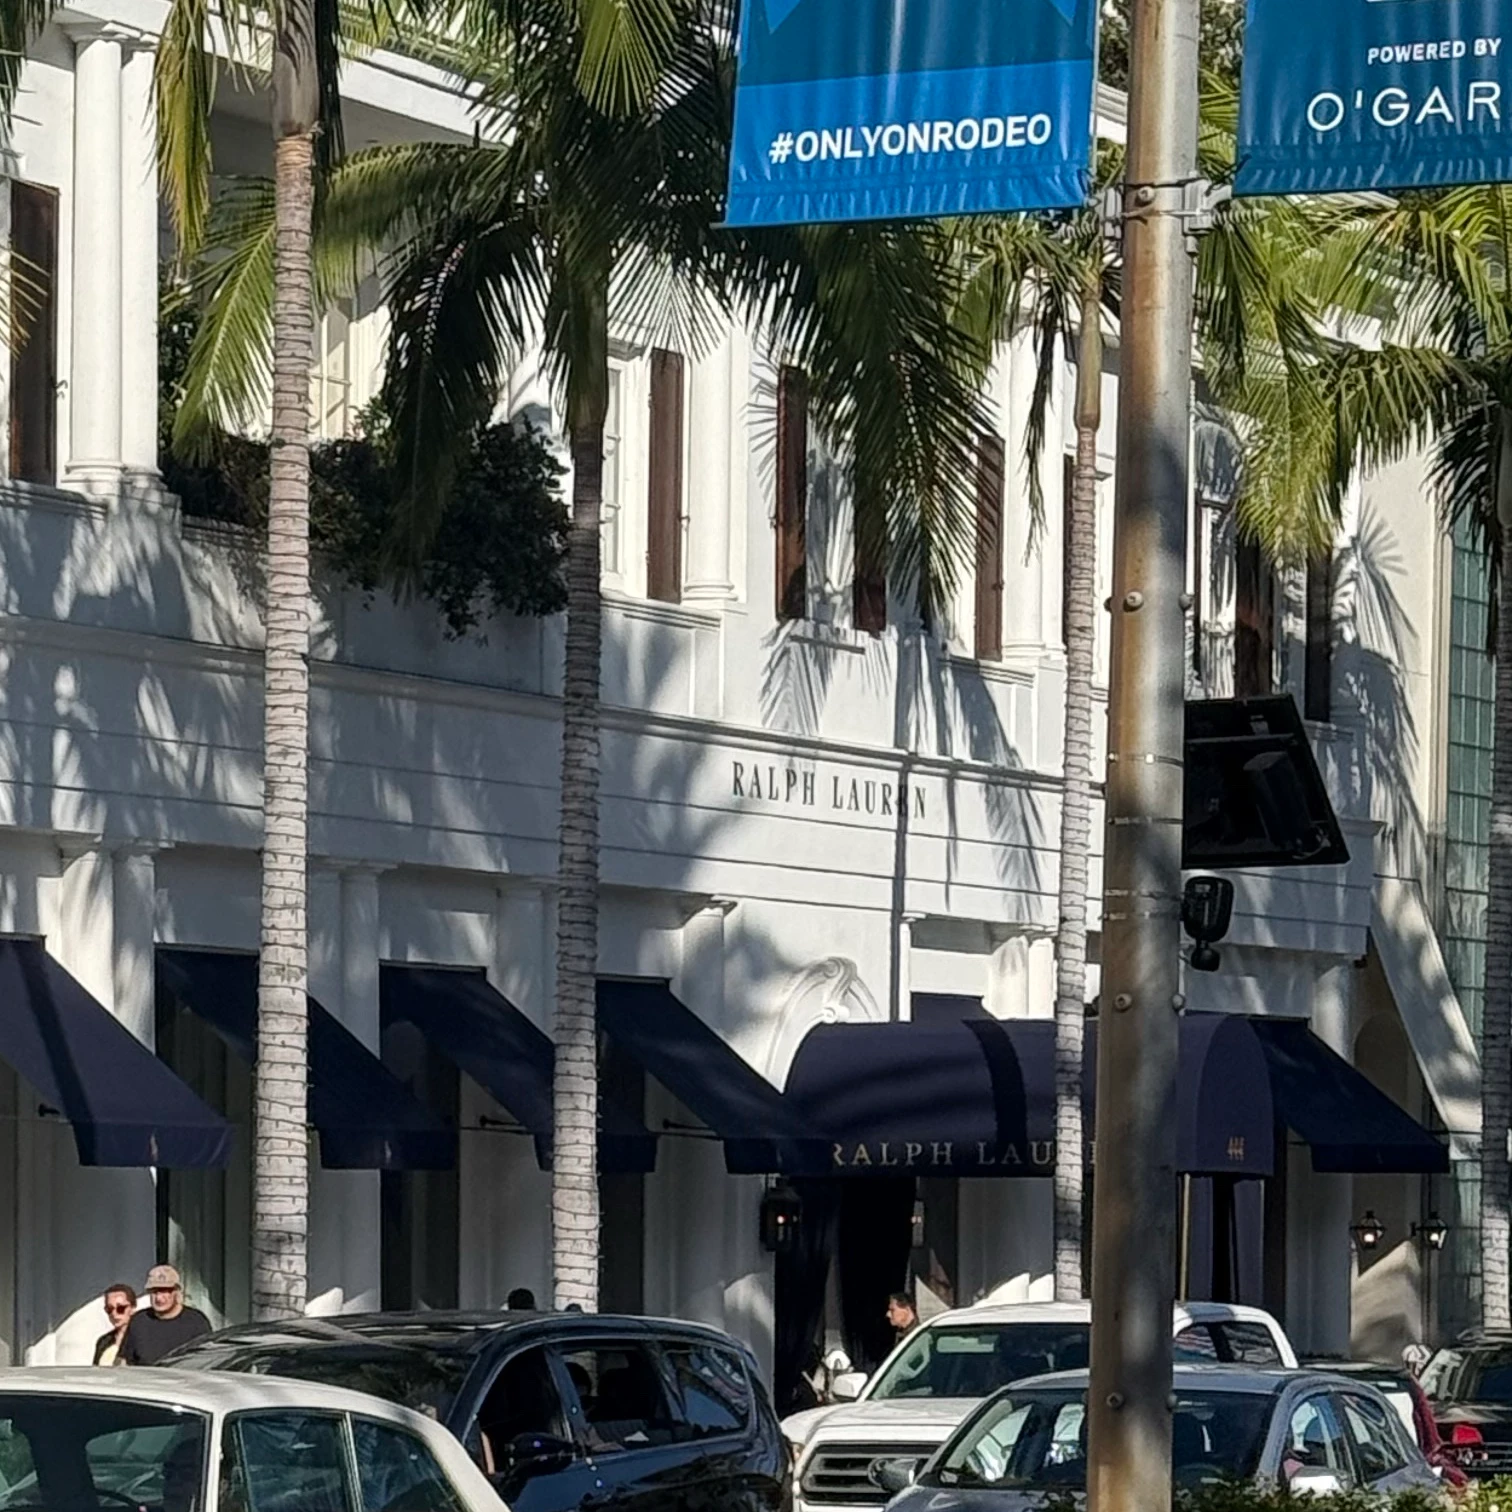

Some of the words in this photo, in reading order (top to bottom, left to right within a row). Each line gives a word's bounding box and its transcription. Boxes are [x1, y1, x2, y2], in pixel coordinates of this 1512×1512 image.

[1367, 40, 1466, 66] POWERED
[1474, 37, 1502, 57] BY
[1307, 81, 1502, 132] O'GAR
[768, 113, 1052, 165] #ONLYONRODEO
[732, 761, 815, 806] RALPH
[831, 775, 927, 819] LAUREN
[833, 1141, 953, 1166] RALPH
